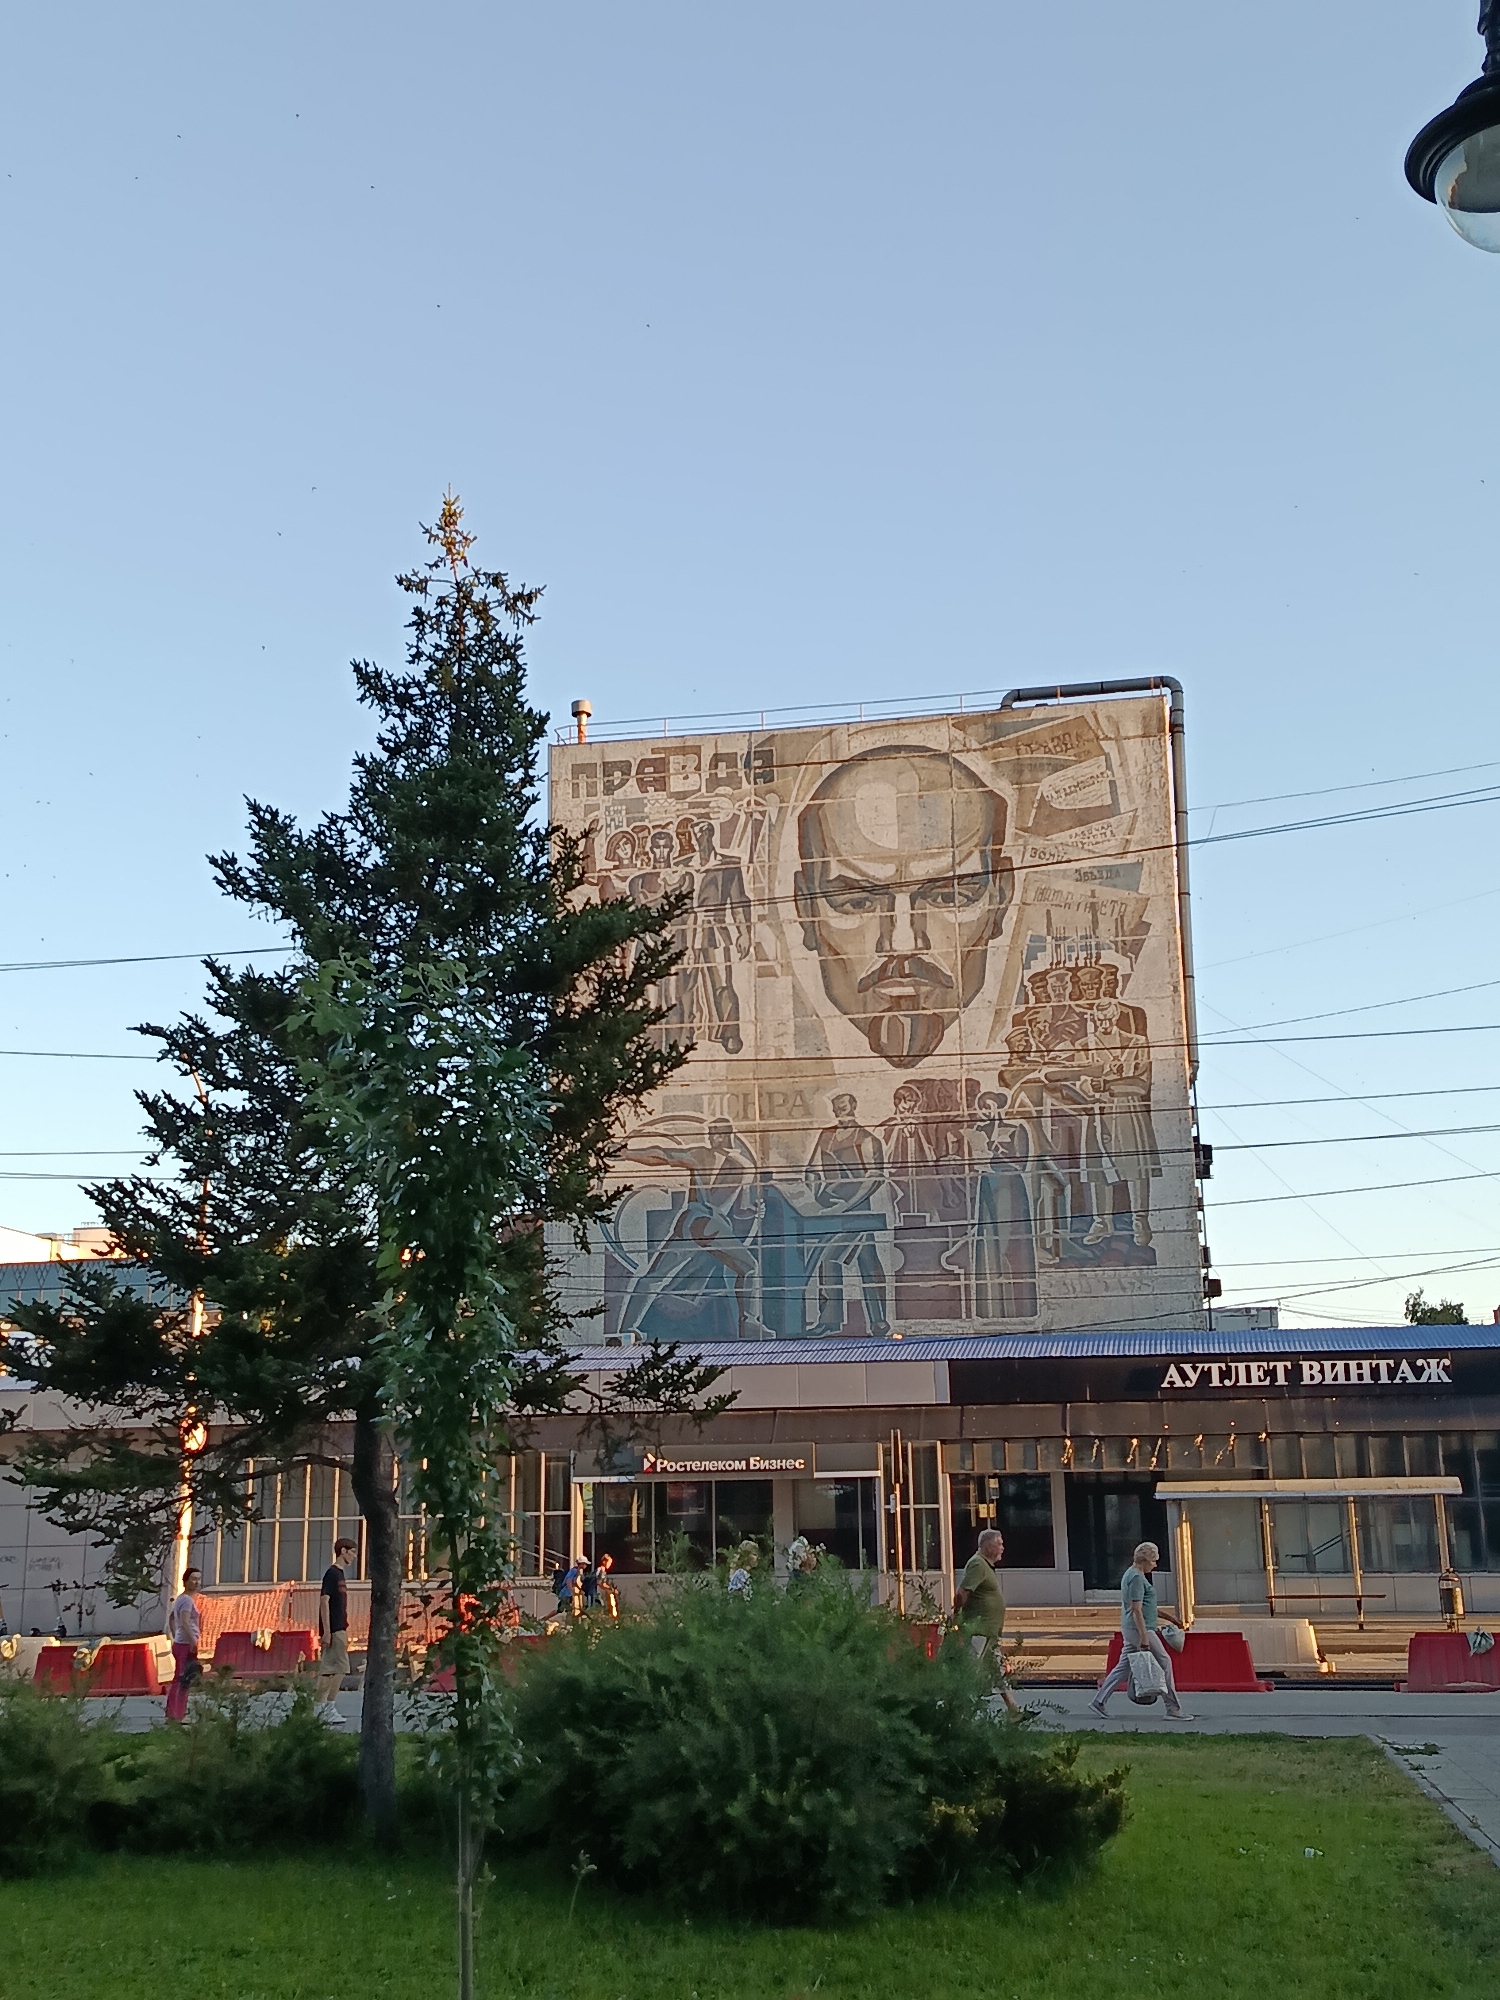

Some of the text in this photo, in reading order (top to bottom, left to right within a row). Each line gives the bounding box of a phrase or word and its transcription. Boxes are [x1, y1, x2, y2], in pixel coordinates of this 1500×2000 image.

[571, 747, 776, 800] ПРАВДА
[1076, 893, 1129, 917] ГАЕТА
[702, 1090, 814, 1119] ИСКРА
[1160, 1358, 1452, 1388] АУТЛЕТ ВИНТАЖ
[656, 1456, 805, 1472] Ростелеком Бизнес
